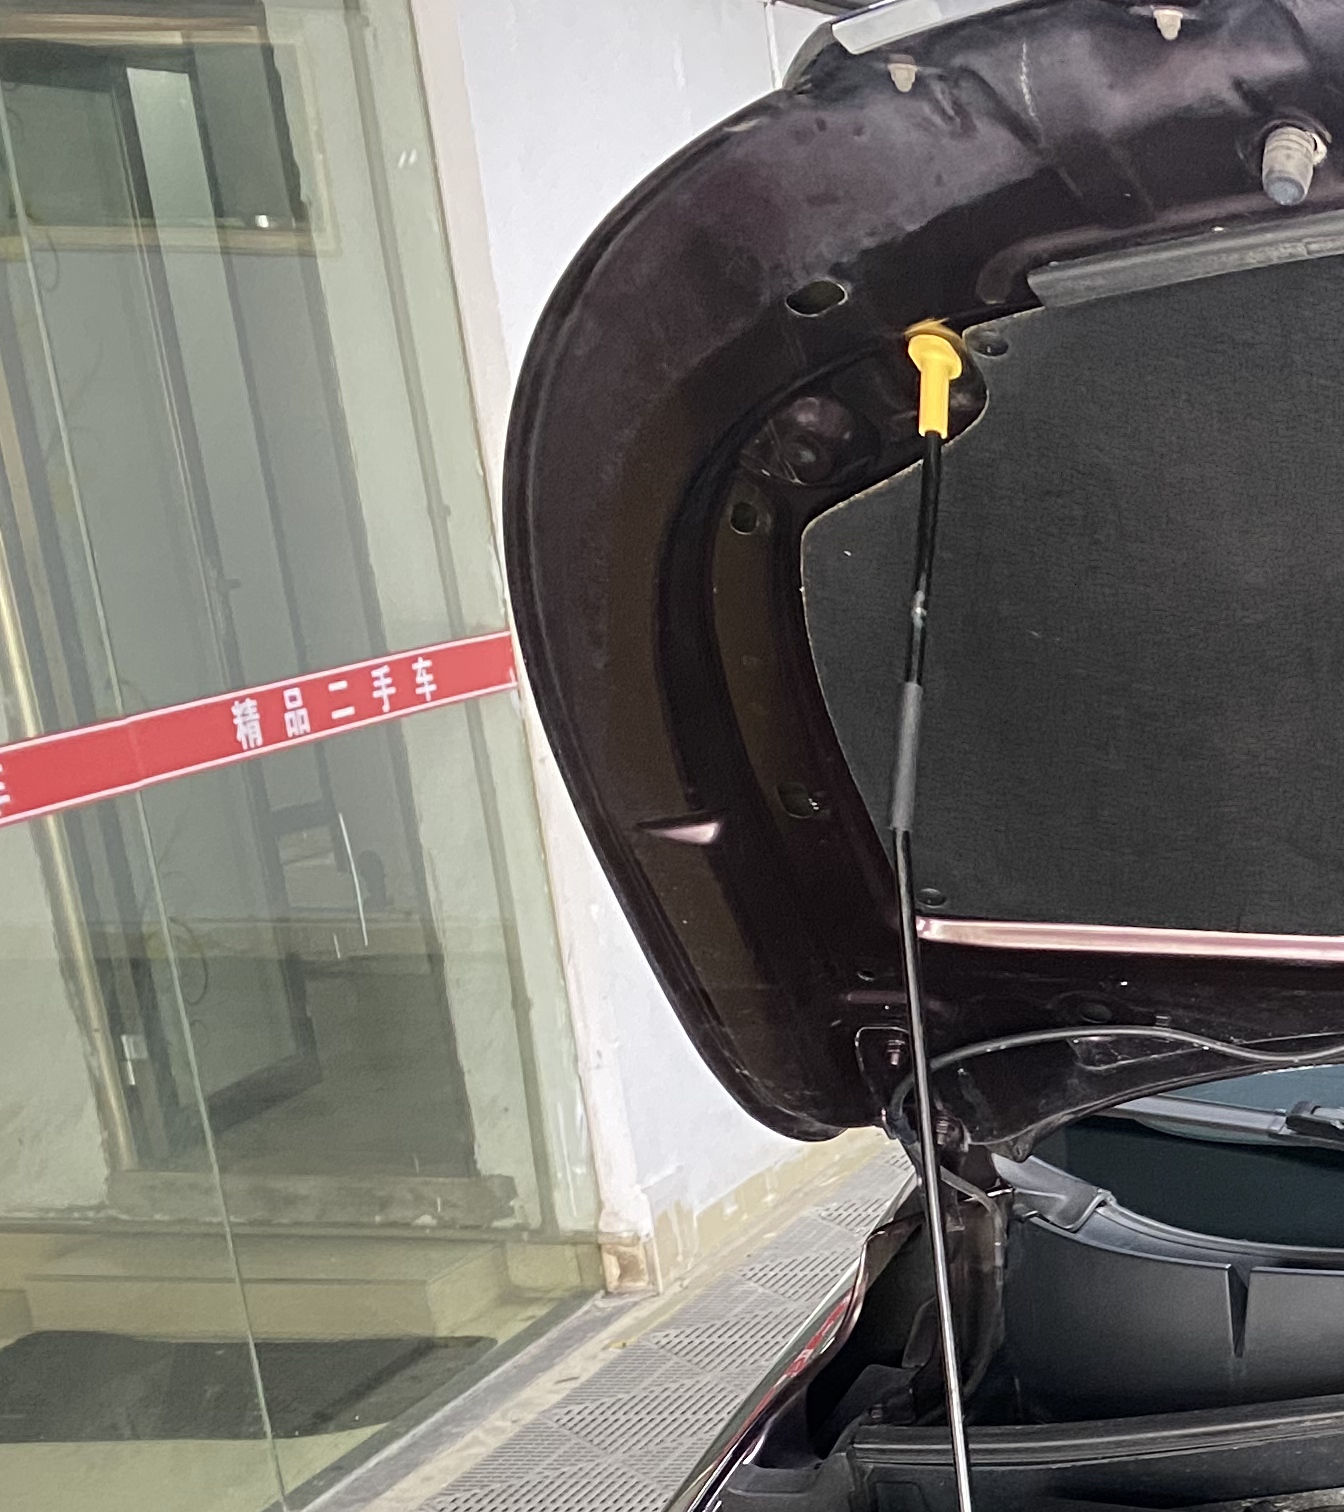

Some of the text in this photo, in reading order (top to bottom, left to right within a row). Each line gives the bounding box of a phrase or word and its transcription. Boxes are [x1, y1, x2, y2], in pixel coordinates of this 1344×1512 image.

[231, 657, 437, 751] 精品二手车
